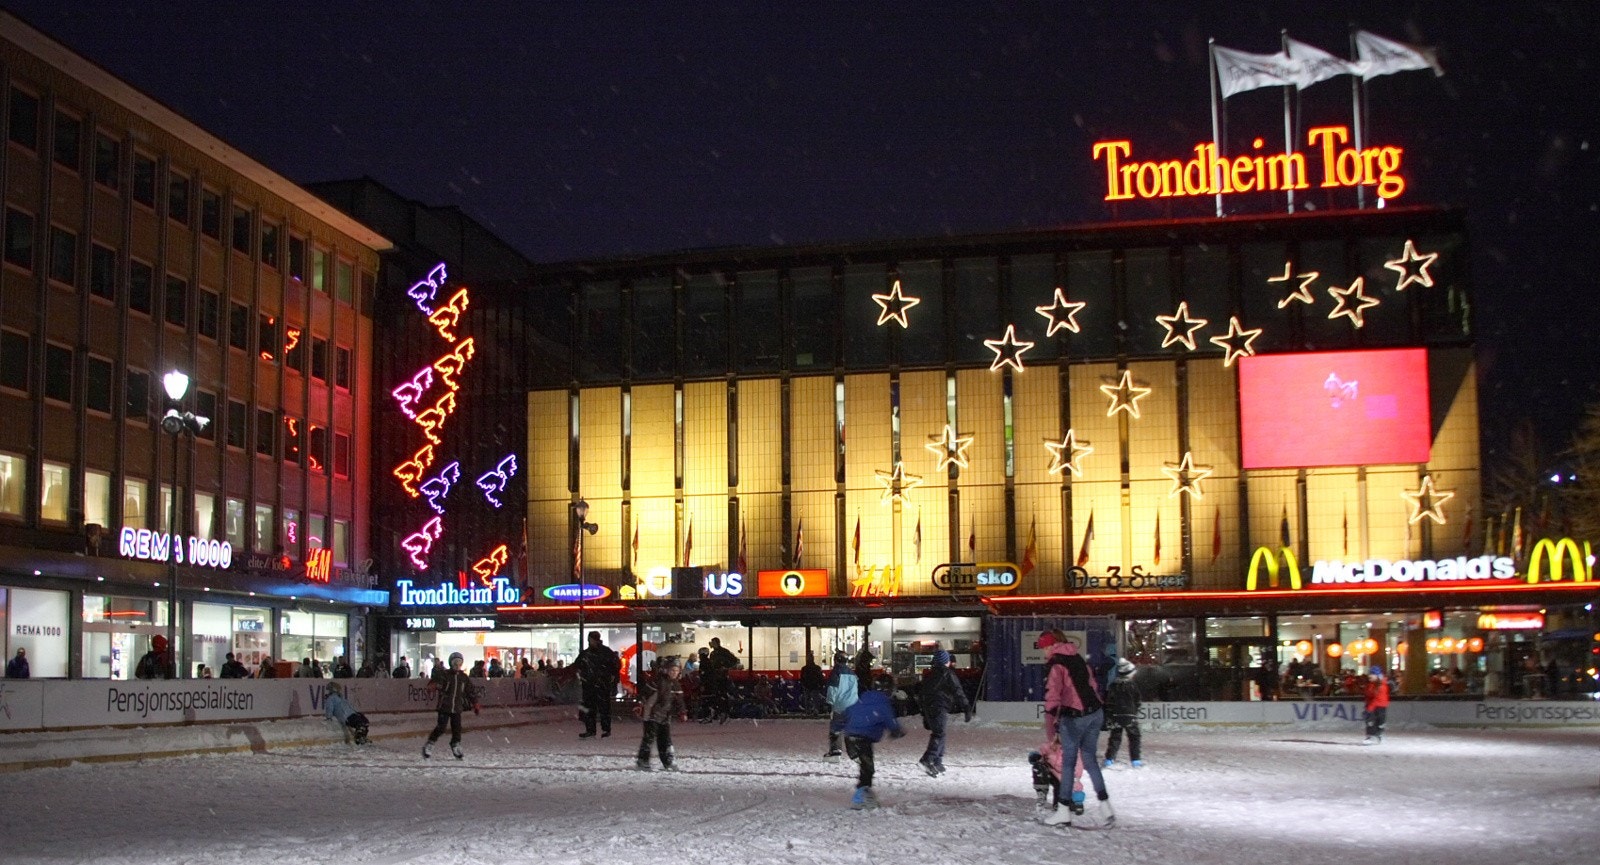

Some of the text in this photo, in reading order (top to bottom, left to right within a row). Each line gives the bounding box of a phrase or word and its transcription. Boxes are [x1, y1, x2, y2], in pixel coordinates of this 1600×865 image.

[1093, 126, 1405, 200] Trondheim Torg
[188, 535, 232, 569] 1000
[306, 547, 332, 583] H&M
[851, 564, 902, 597] H&M
[1066, 565, 1100, 589] De
[1106, 565, 1123, 589] 3
[1311, 555, 1515, 584] McDonald's
[397, 579, 493, 605] Trondheim
[16, 625, 61, 636] REMA 1000
[107, 686, 254, 718] Pensjonsspesialisten
[1292, 703, 1365, 721] VITAL
[1475, 703, 1600, 722] Pensjonsspesi
